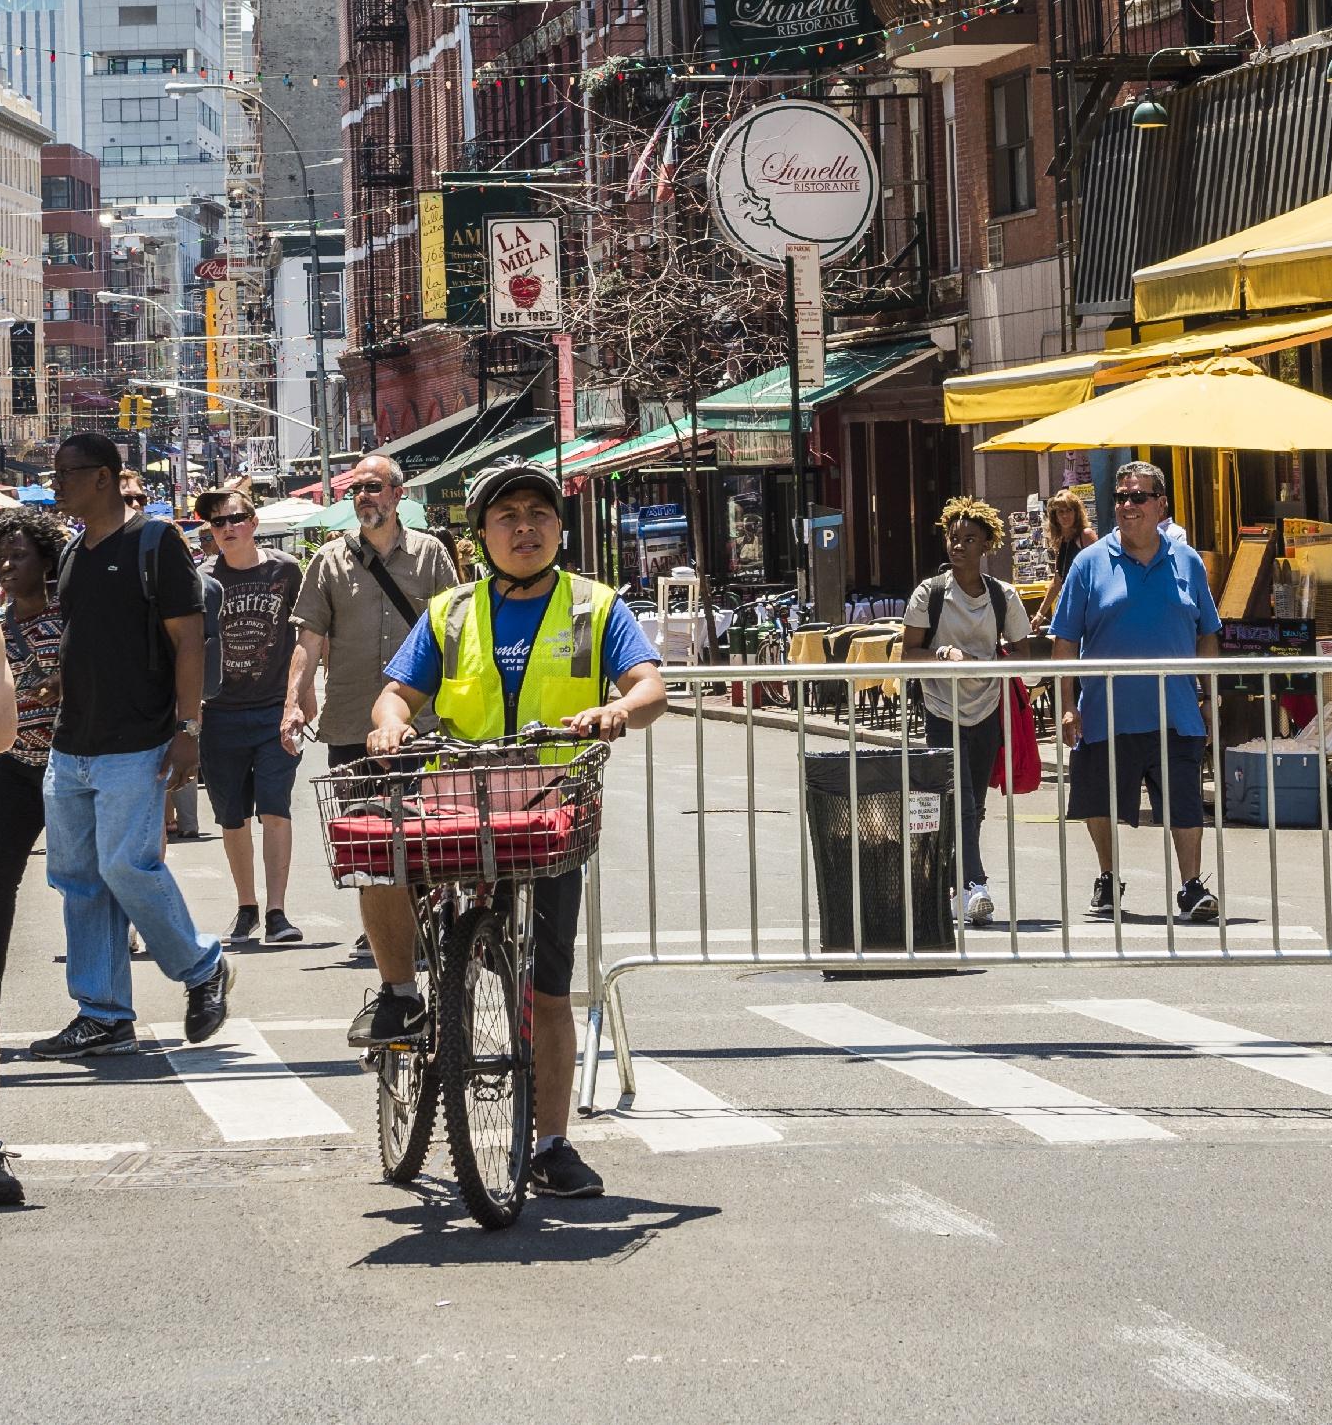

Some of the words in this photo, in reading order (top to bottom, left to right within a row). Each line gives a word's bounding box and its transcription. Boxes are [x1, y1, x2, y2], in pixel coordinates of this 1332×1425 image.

[777, 12, 858, 35] RISTORANTE
[757, 151, 860, 185] Lunella
[794, 181, 860, 192] RISTORANTE
[495, 225, 532, 254] LA
[498, 242, 552, 275] MELA
[500, 312, 523, 324] EST
[822, 529, 835, 548] P
[245, 621, 265, 629] JONES
[1225, 623, 1280, 642] FROZEN
[225, 659, 252, 668] DENIM
[925, 820, 938, 830] FINE
